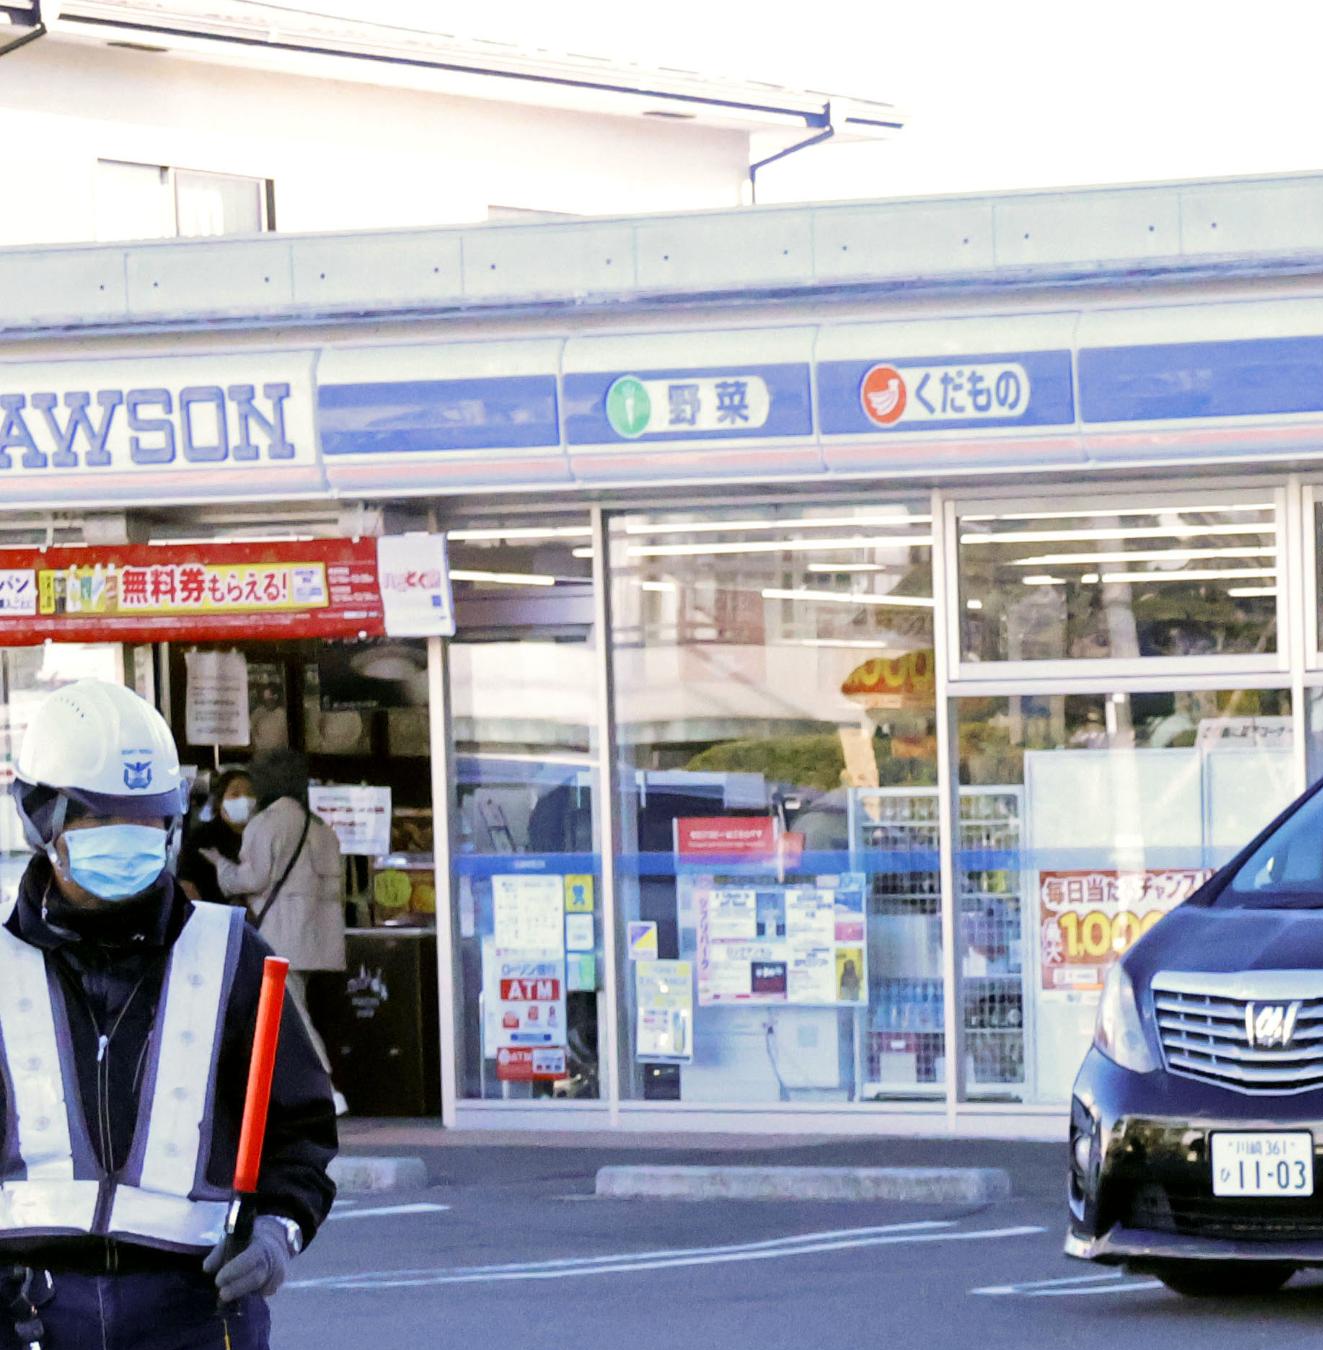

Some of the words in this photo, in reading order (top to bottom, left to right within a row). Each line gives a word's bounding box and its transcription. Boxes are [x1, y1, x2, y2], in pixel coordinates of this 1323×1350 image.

[668, 381, 749, 425] 野菜
[915, 370, 1021, 414] くだもの
[509, 980, 554, 1000] ATM
[1239, 1160, 1306, 1189] 11-03
